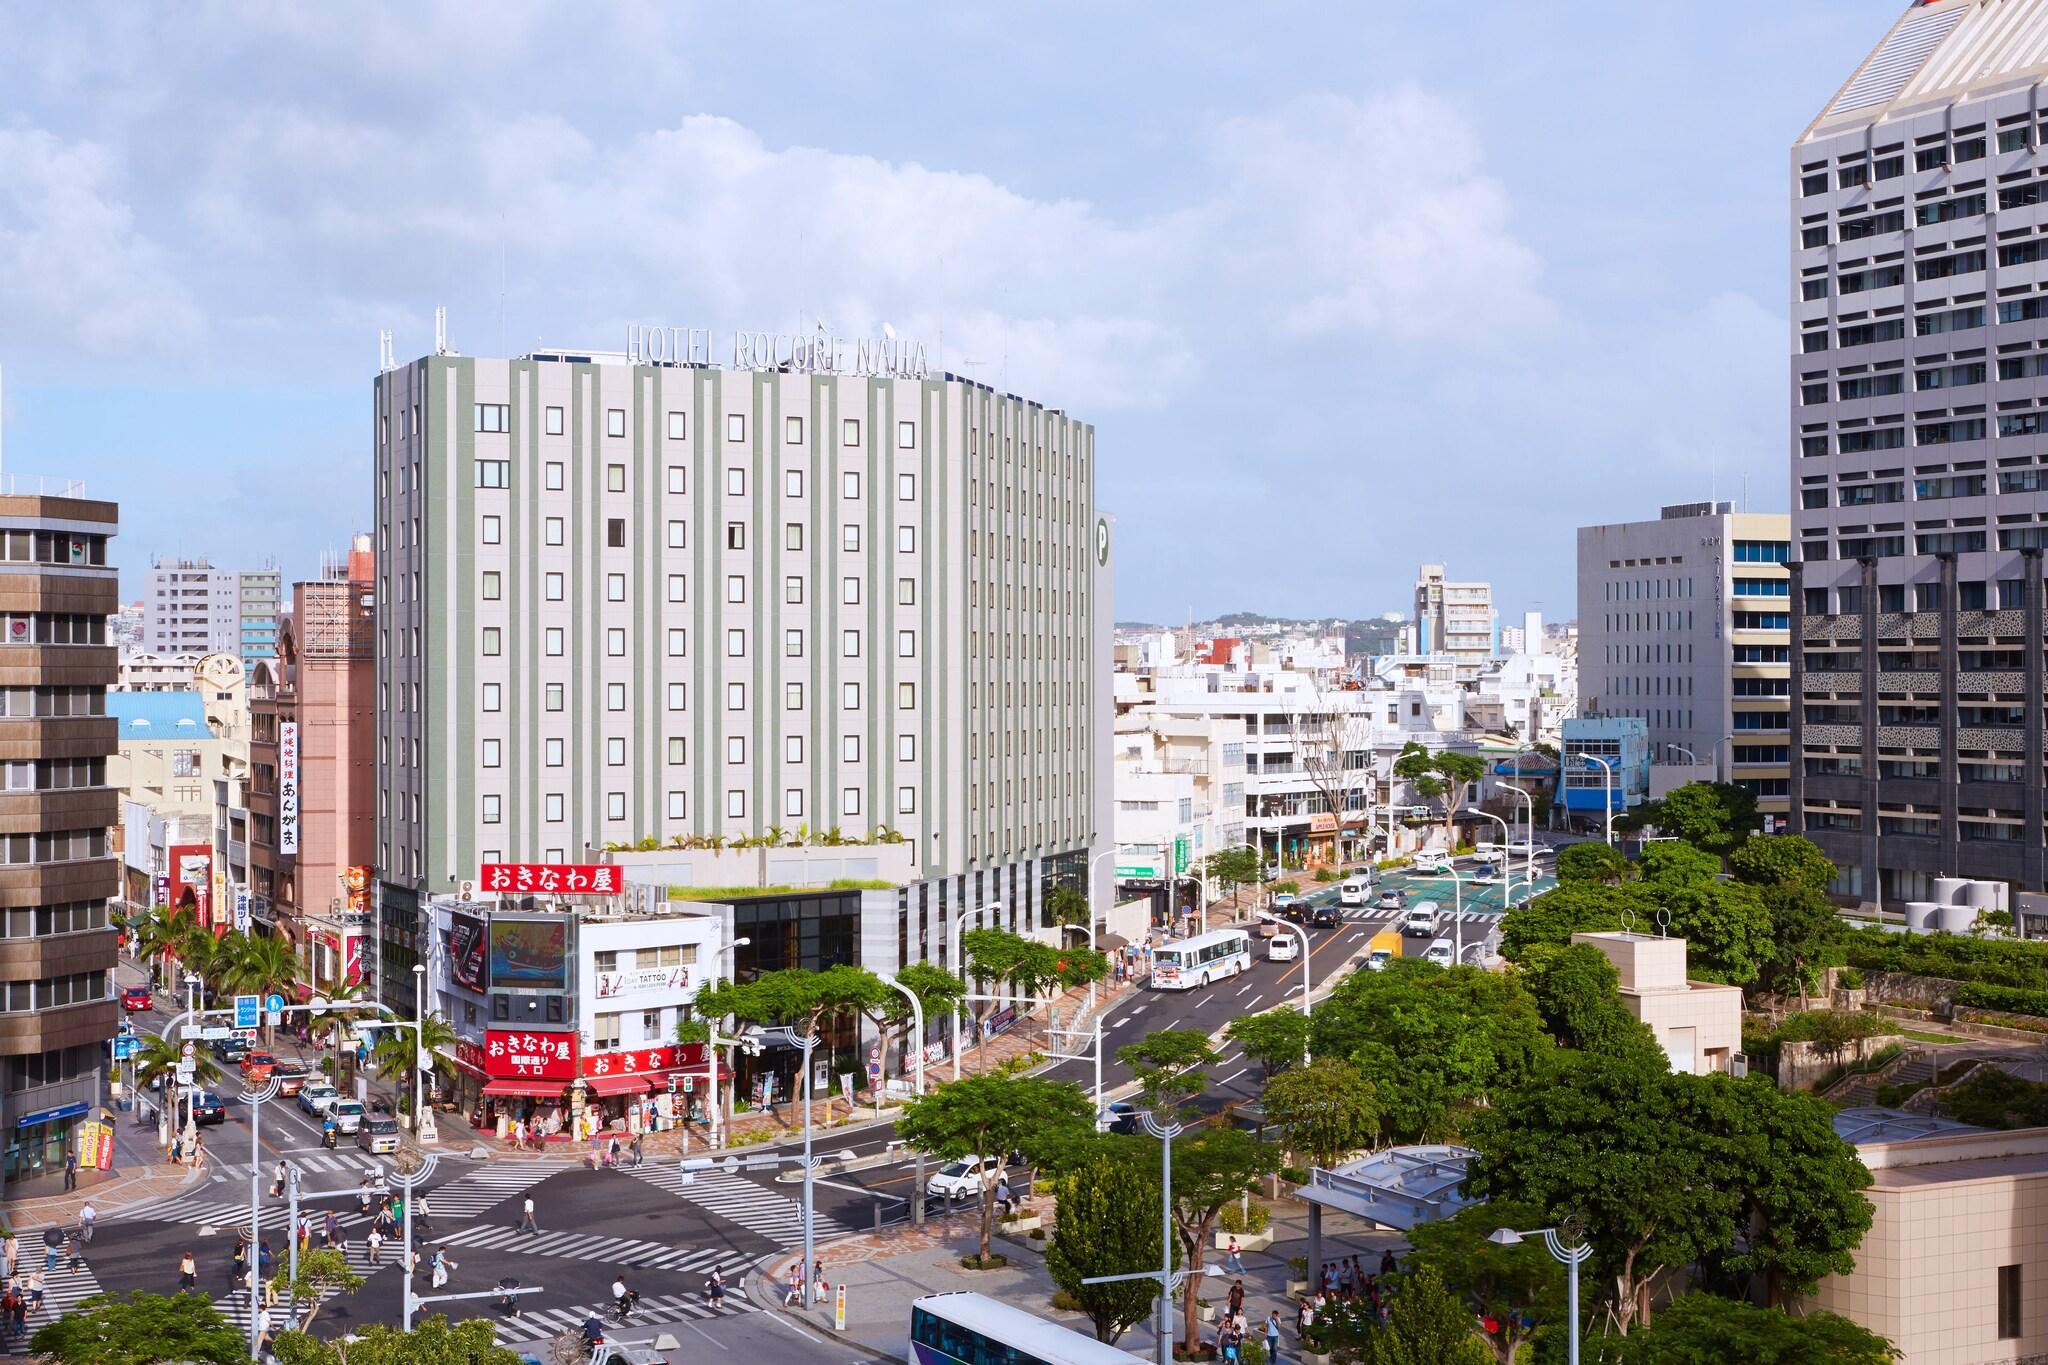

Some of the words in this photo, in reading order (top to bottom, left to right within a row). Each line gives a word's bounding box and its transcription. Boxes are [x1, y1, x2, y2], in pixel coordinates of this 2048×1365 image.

[627, 325, 720, 366] HOTEL
[856, 336, 928, 378] NAHA
[1098, 524, 1107, 560] P
[284, 726, 295, 780] 沖縄地料理
[282, 781, 297, 846] あんがま
[489, 865, 614, 892] おきなわ屋
[640, 973, 667, 983] TATTOO
[488, 1033, 571, 1060] おきなわ屋
[510, 1055, 549, 1065] 国際通り
[594, 1043, 711, 1075] おきなわ屋
[517, 1065, 543, 1075] 入口
